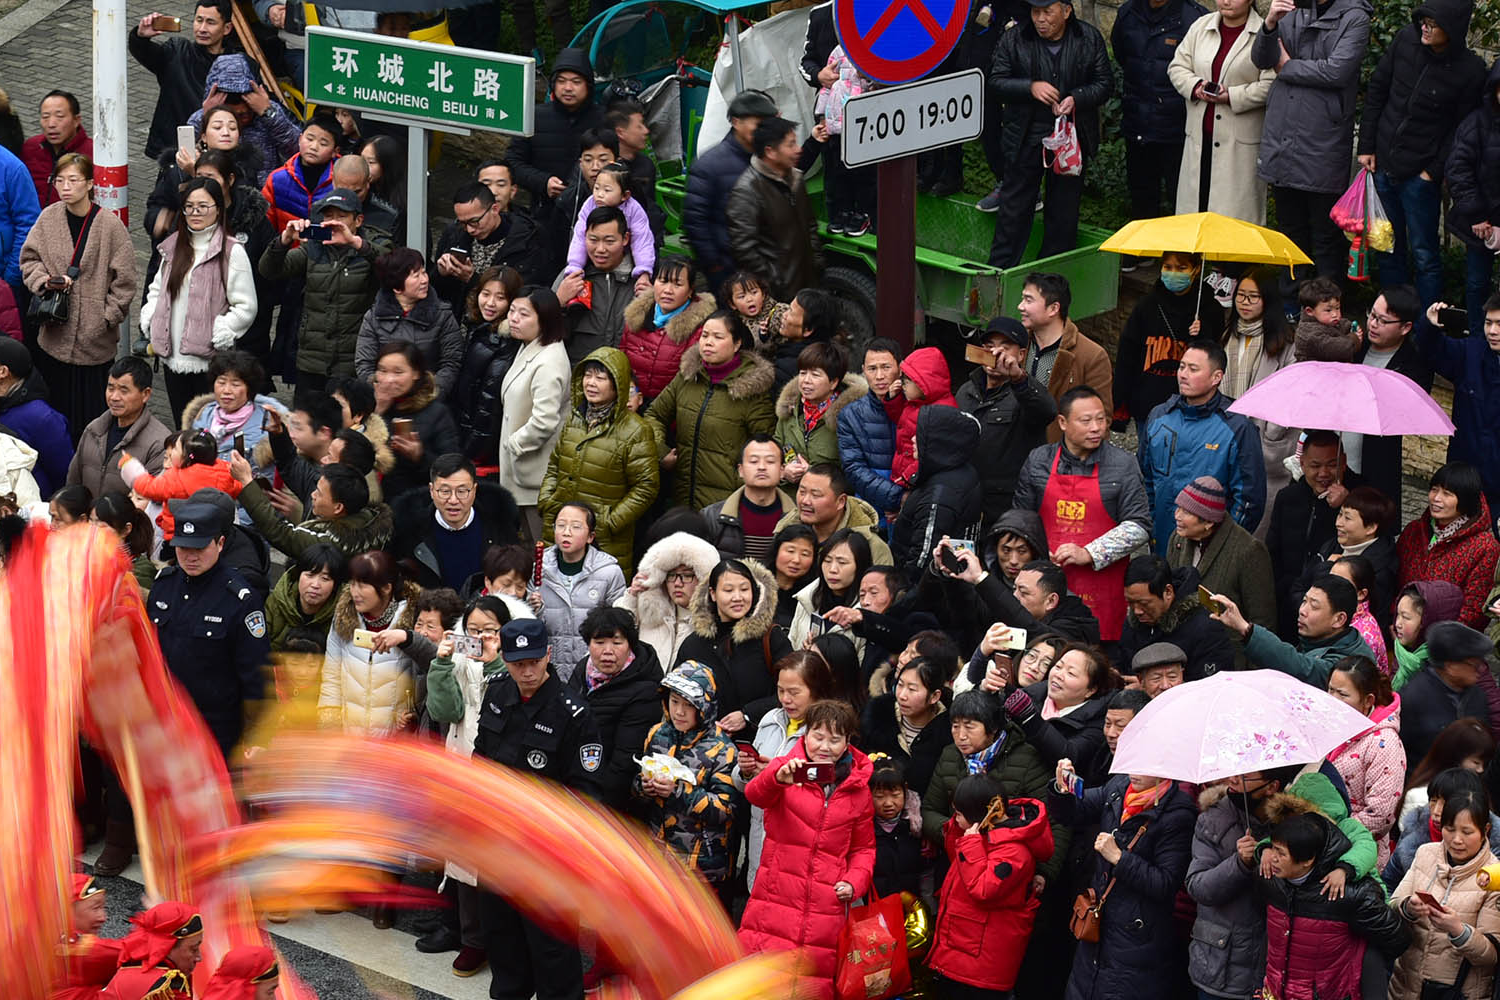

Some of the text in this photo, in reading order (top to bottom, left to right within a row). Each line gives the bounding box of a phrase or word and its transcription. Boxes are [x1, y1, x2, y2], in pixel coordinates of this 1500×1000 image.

[331, 46, 501, 101] 环城北路
[336, 84, 346, 96] 北
[353, 86, 478, 117] HUANCHENG BEILU
[854, 94, 973, 145] 7:00 19:00
